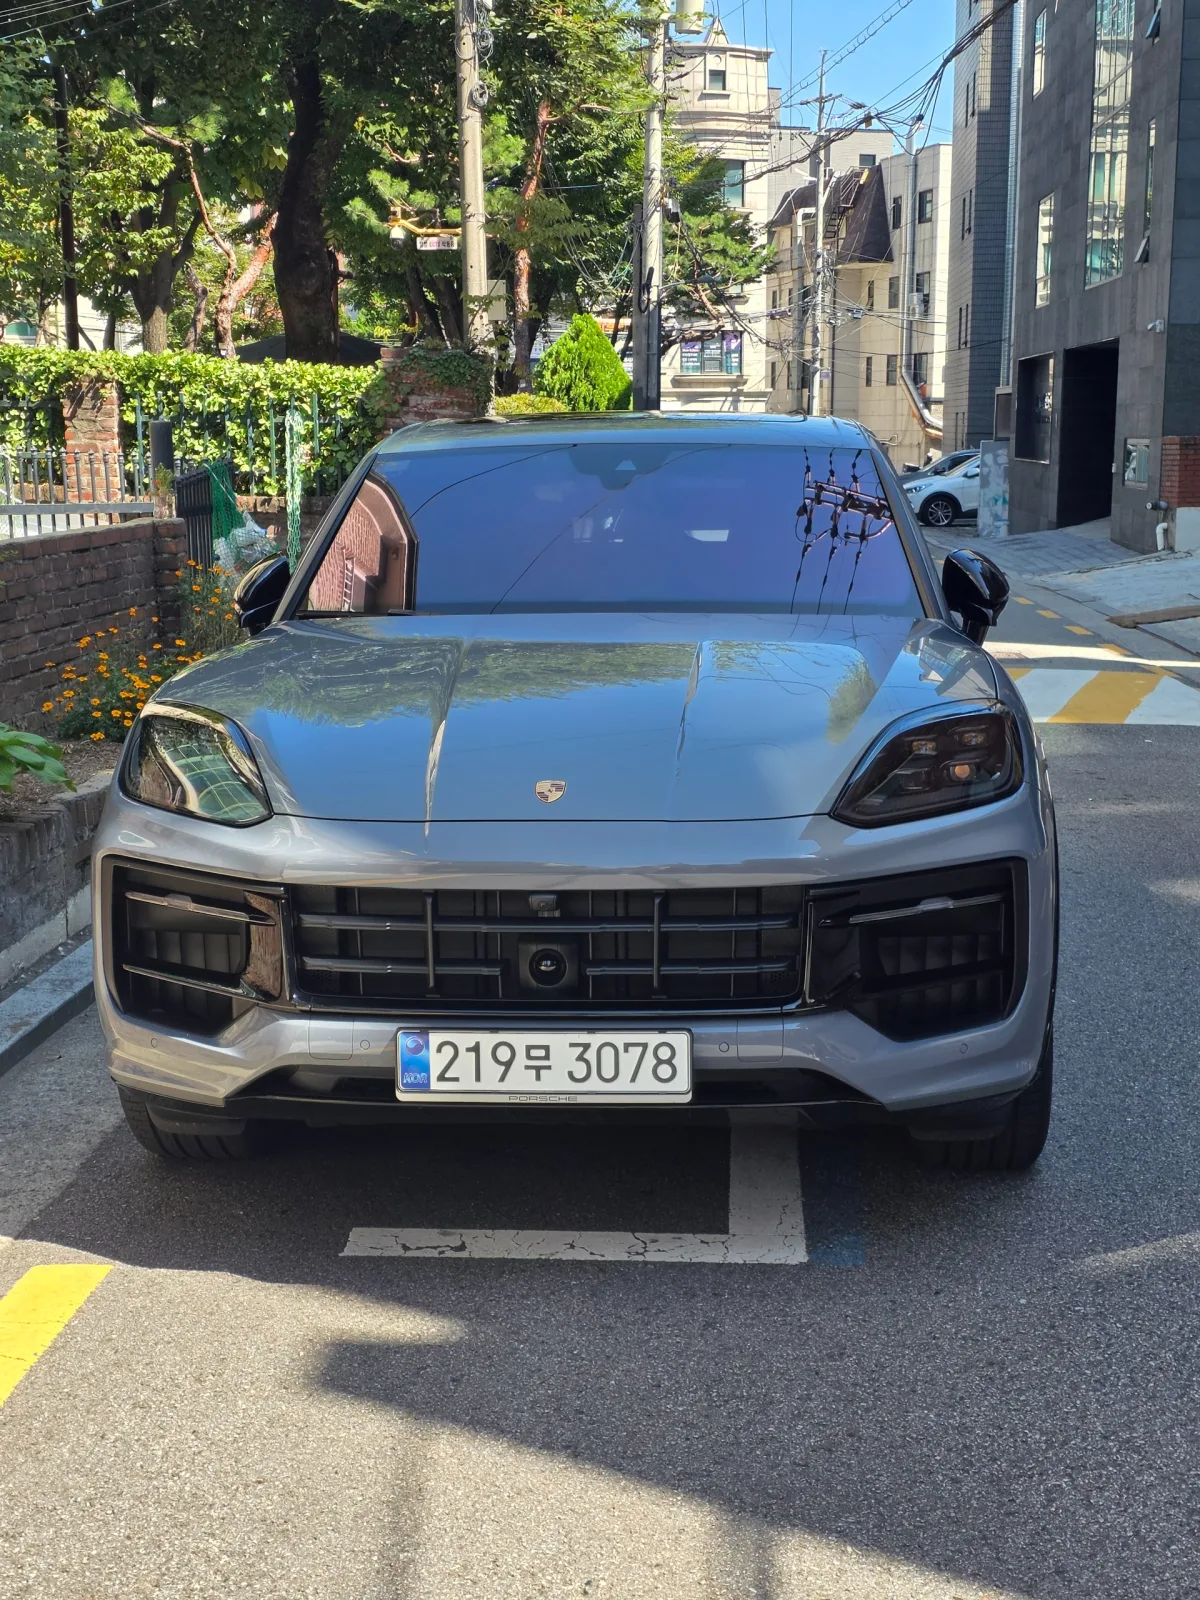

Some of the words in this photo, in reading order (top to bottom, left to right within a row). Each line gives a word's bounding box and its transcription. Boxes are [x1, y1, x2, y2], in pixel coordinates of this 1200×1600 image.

[435, 1040, 552, 1083] 219무
[567, 1041, 678, 1084] 3078
[403, 1072, 428, 1084] KOR
